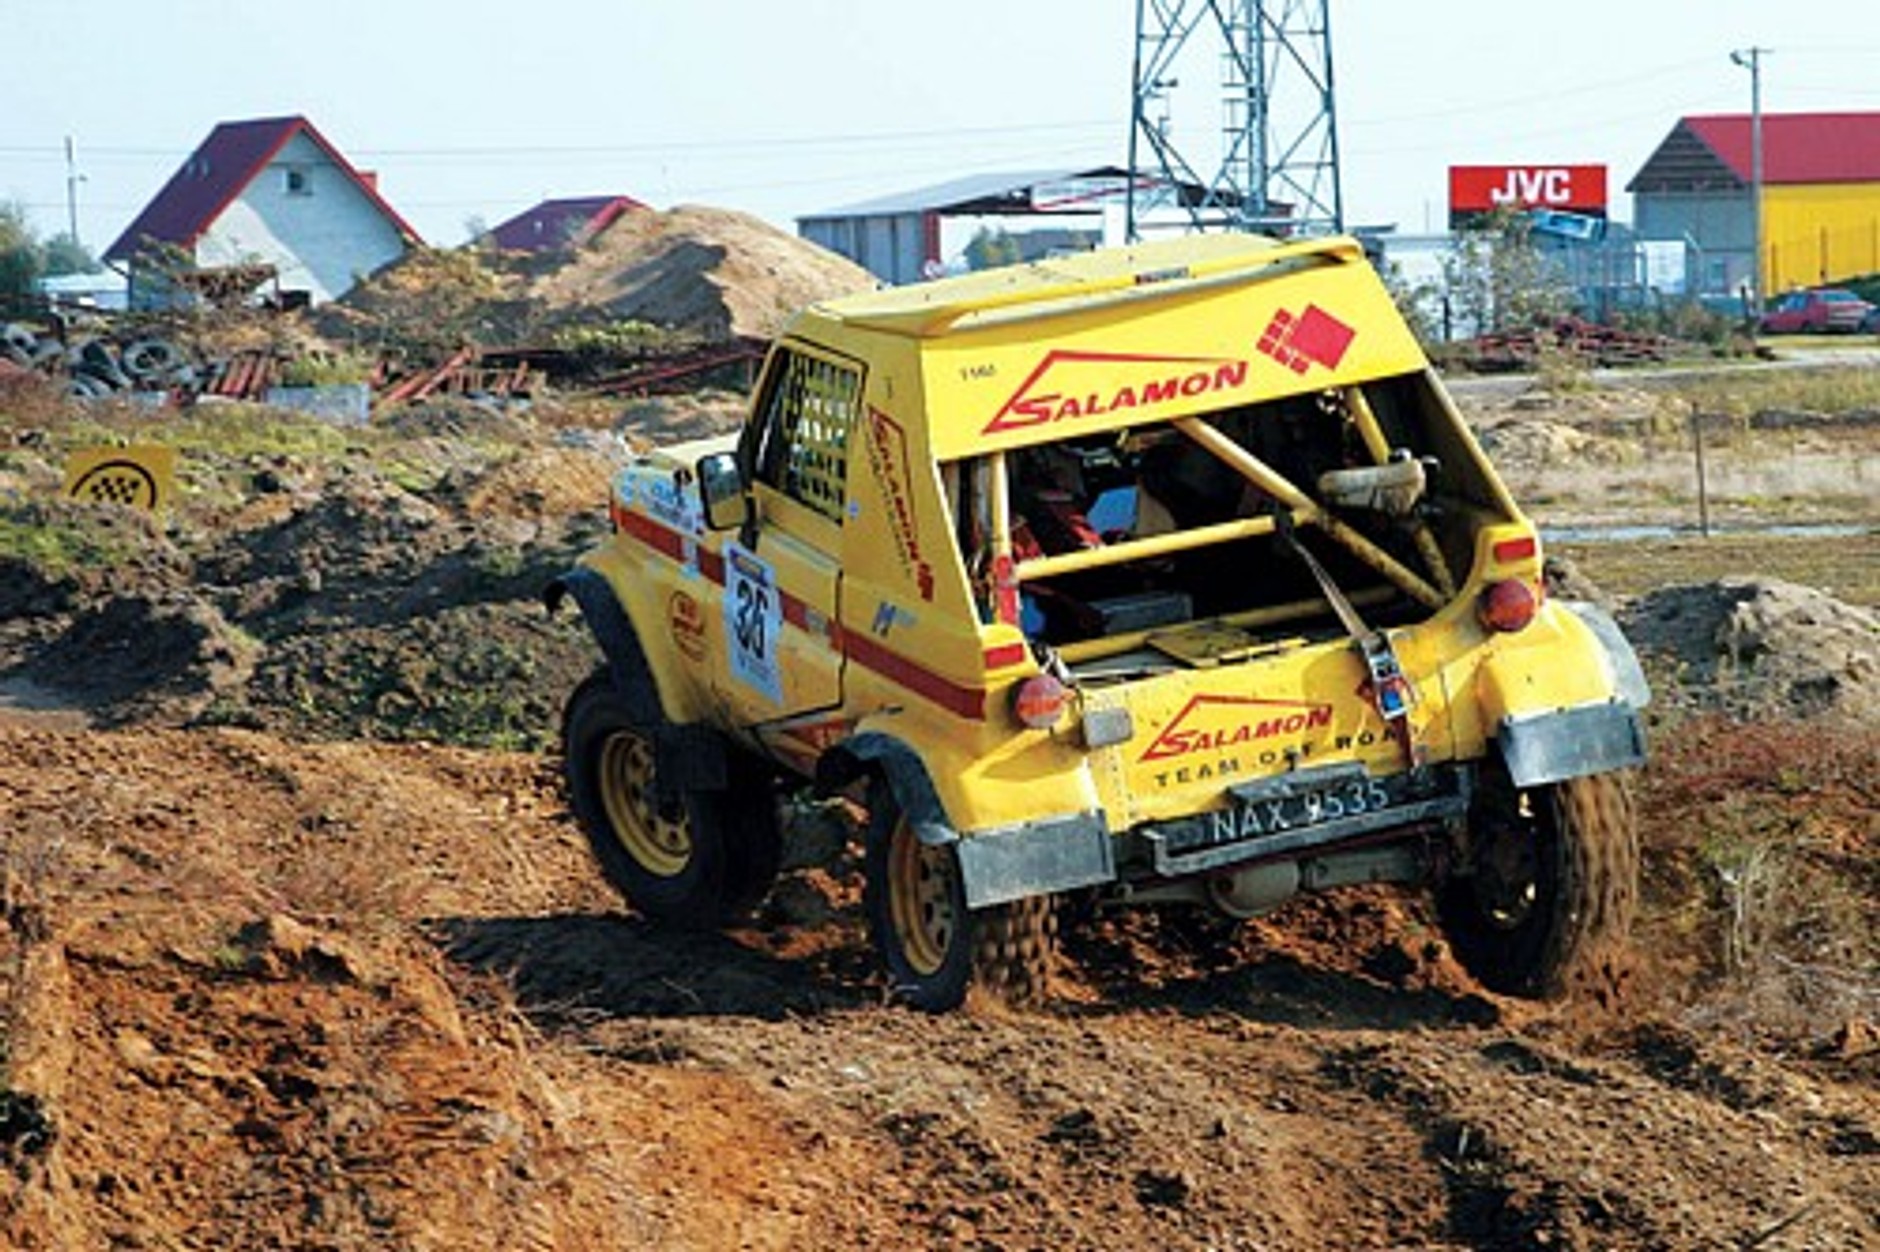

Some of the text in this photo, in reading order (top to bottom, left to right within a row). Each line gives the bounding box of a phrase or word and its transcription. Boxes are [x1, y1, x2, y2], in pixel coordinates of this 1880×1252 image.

[1491, 169, 1570, 203] JVC
[986, 360, 1250, 433] SALAMON
[1140, 704, 1333, 760] SALAMON
[1154, 758, 1240, 787] TEAM
[1212, 778, 1391, 841] NAX 9535
